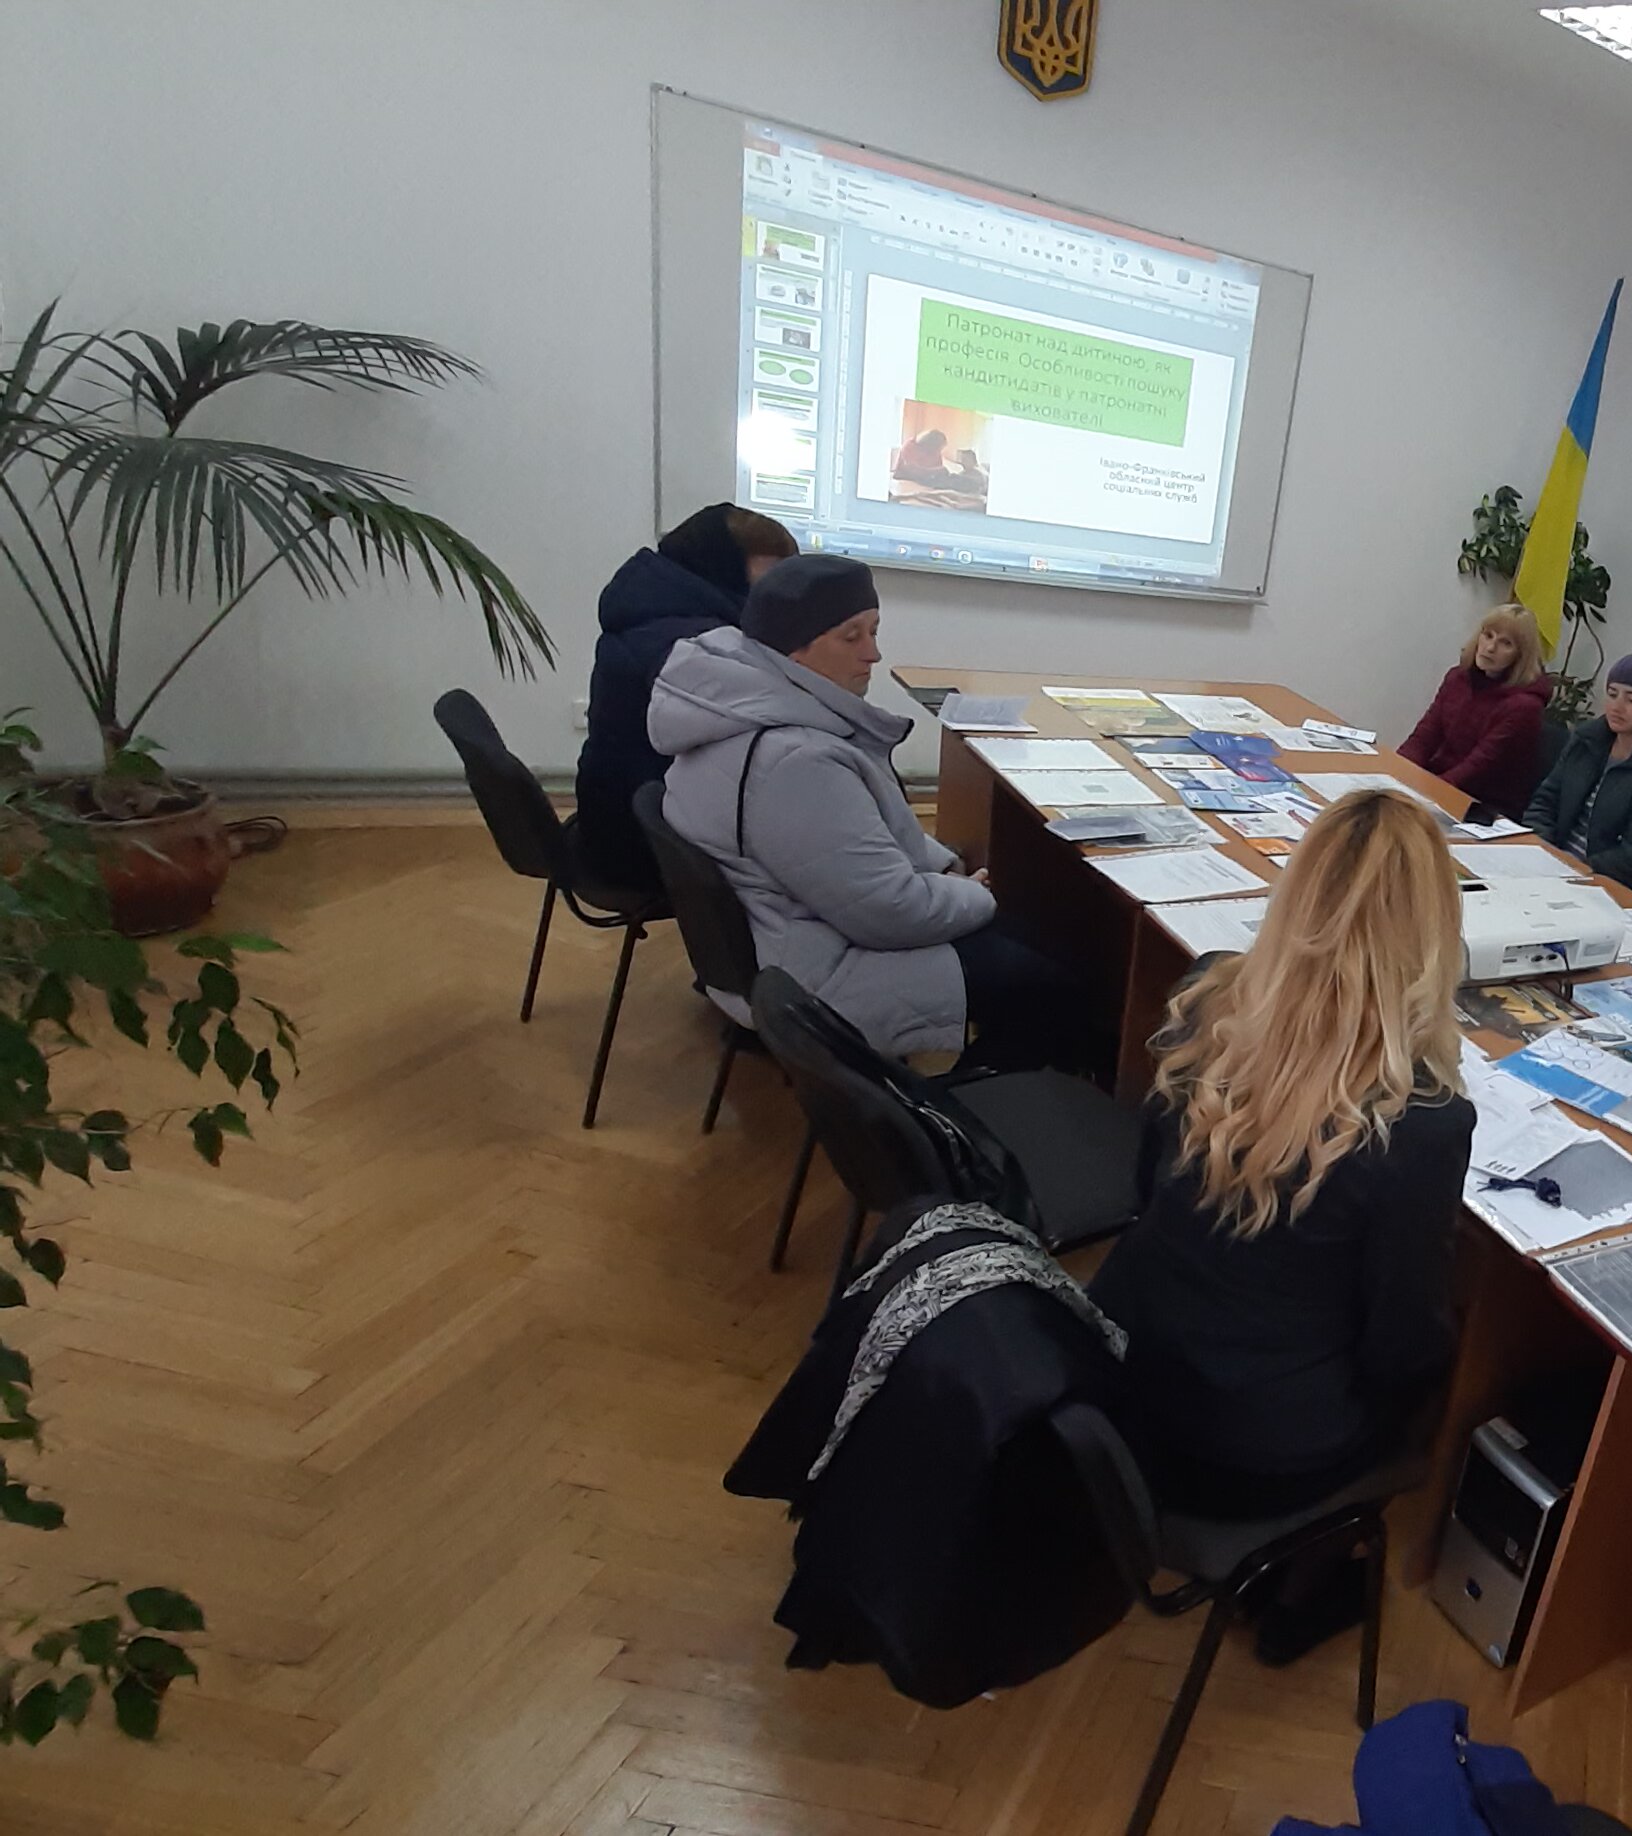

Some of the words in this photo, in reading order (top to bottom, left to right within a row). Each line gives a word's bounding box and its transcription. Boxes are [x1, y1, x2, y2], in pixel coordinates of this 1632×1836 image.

[947, 313, 1032, 344] Патронат
[1036, 334, 1068, 354] над
[1155, 360, 1172, 375] як
[1018, 351, 1124, 388] Особливості
[1127, 376, 1186, 402] пошуку
[1010, 398, 1104, 428] вихователі
[1065, 385, 1076, 401] у
[1079, 389, 1168, 418] патронатні
